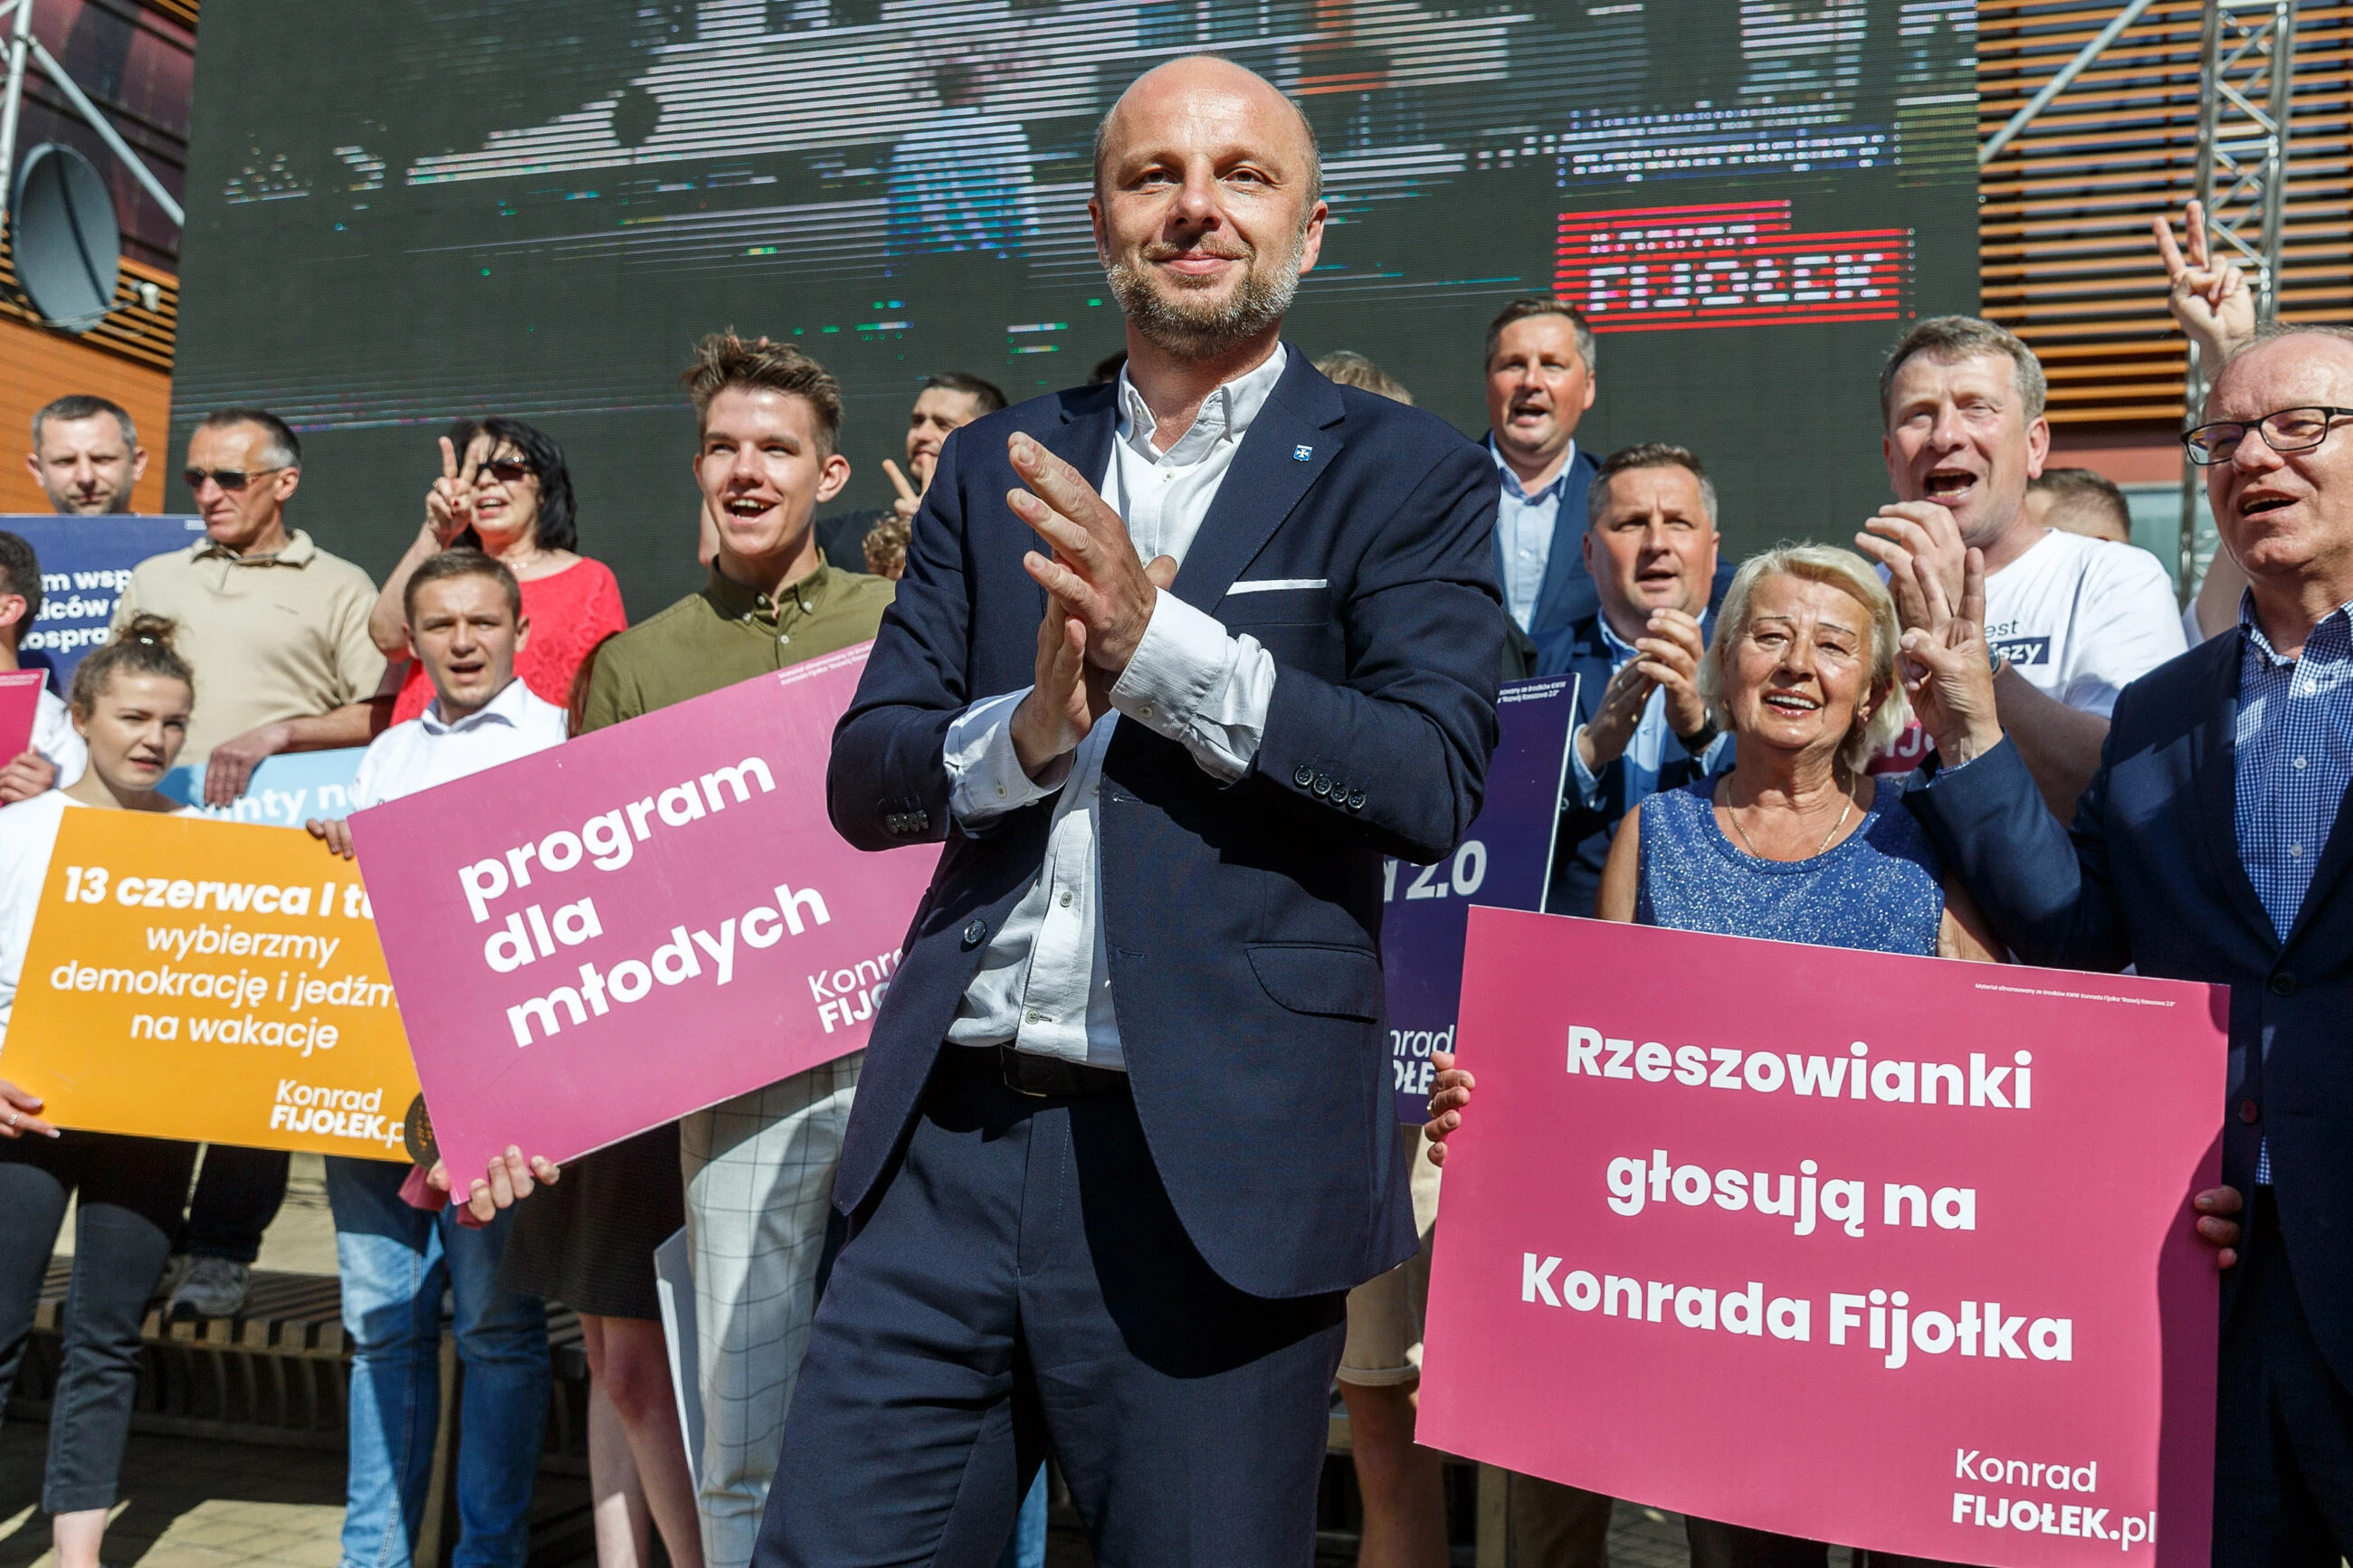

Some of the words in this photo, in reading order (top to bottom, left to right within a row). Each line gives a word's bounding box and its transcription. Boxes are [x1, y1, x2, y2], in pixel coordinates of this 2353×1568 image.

[39, 573, 71, 593] m
[72, 569, 133, 594] wsp
[35, 594, 110, 621] iców
[1984, 619, 2019, 639] est
[20, 626, 110, 654] ospra
[1993, 642, 2043, 666] szy
[459, 756, 776, 924] program
[65, 865, 110, 905] 13
[115, 876, 312, 917] czerwca
[146, 922, 340, 970] wybierzmy
[484, 897, 604, 973] dla
[50, 959, 269, 1009] demokrację
[276, 970, 289, 1002] i
[290, 972, 398, 1012] jedźm
[506, 883, 831, 1048] młodych
[129, 1014, 180, 1041] na
[188, 1013, 339, 1058] wakacje
[1390, 1023, 1455, 1058] nrad
[1567, 1025, 2034, 1109] Rzeszowianki
[275, 1079, 383, 1114] Konrad
[270, 1104, 405, 1150] FIJOŁEK.p
[1606, 1149, 1865, 1238] głosują
[1883, 1183, 1976, 1231] na
[1521, 1252, 1811, 1342] Konrada
[1829, 1288, 2072, 1369] Fijołka
[1956, 1448, 2097, 1493] Konrad
[1952, 1492, 2157, 1552] FIJOŁEK.pl
